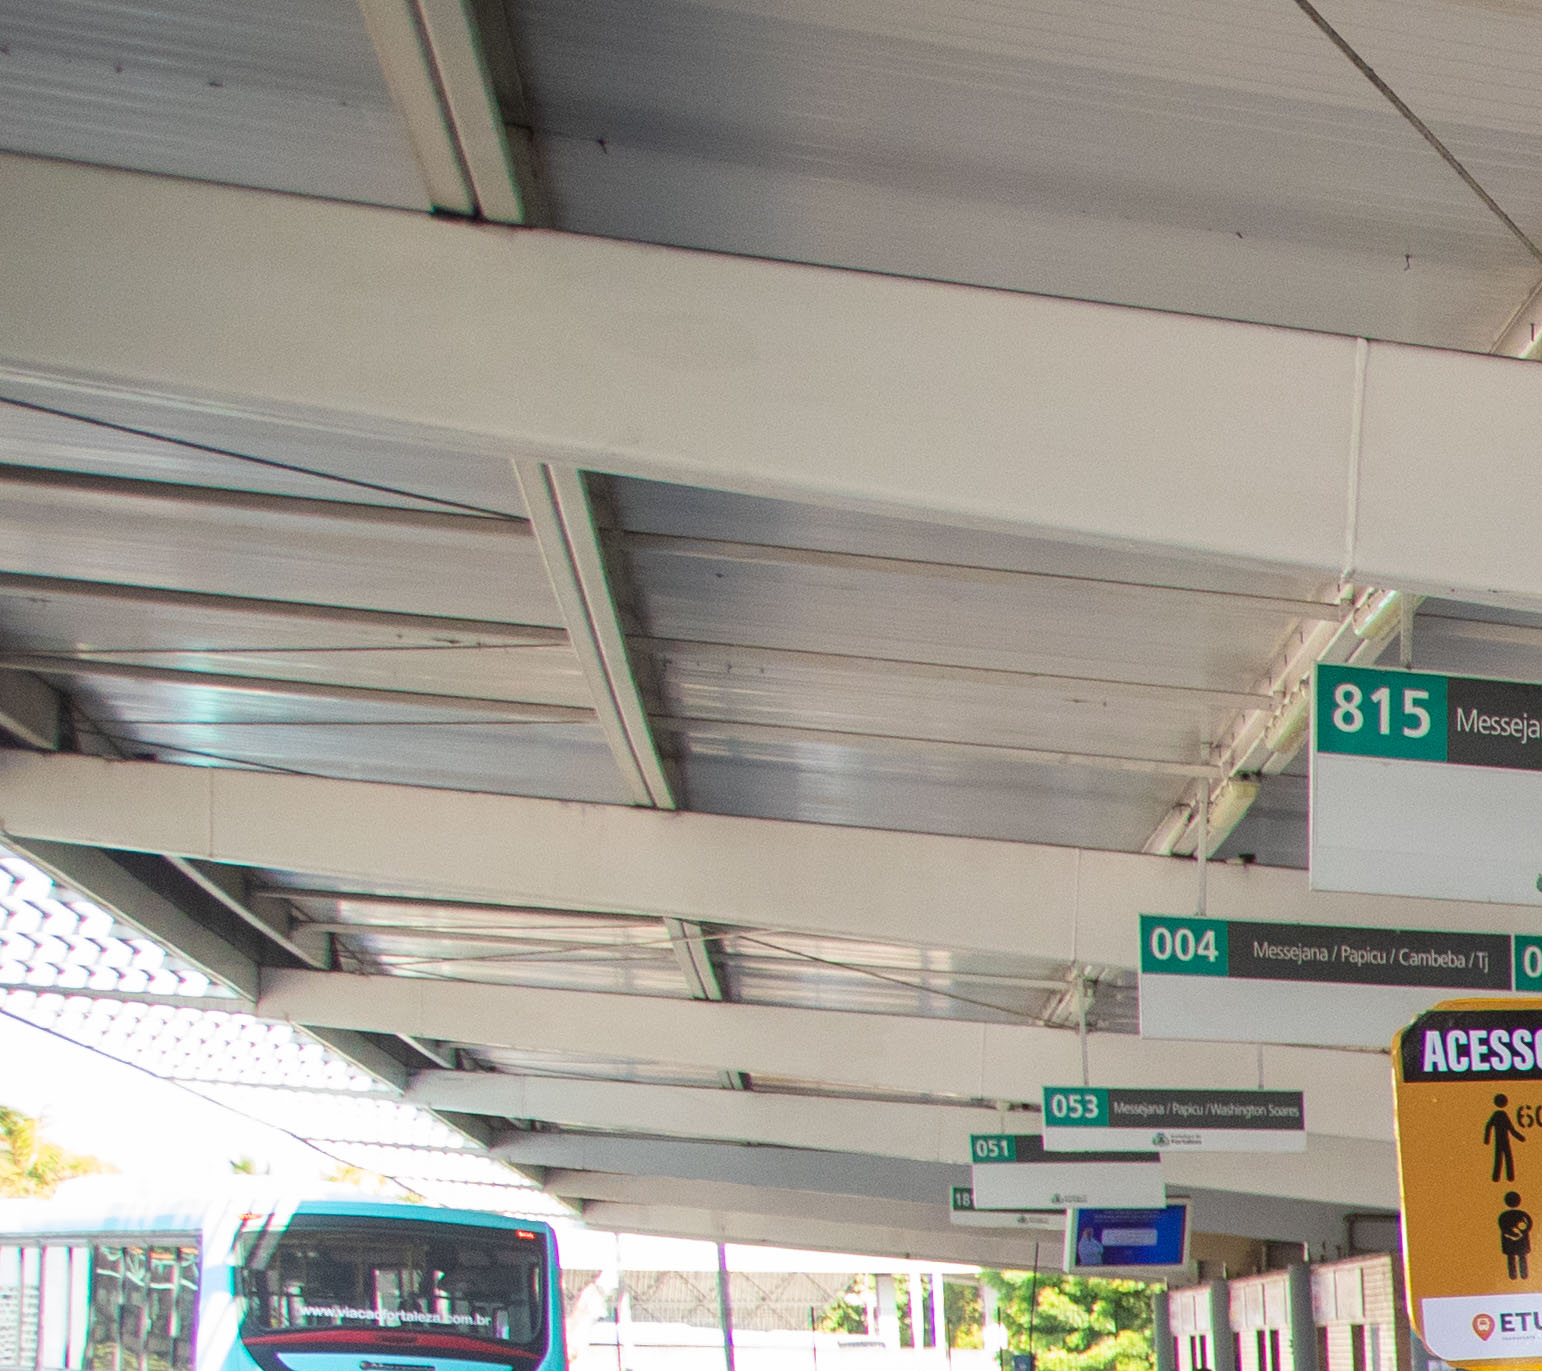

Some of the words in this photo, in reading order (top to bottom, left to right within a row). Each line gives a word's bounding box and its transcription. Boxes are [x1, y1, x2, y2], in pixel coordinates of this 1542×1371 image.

[1332, 683, 1432, 739] 815
[1151, 927, 1218, 962] 004
[1253, 941, 1328, 965] Messejana
[1341, 949, 1387, 967] Papicu
[1399, 948, 1466, 969] Cambeba
[1477, 952, 1489, 973] Tj
[1051, 1094, 1099, 1119] 053
[1113, 1101, 1165, 1118] Messejana
[1173, 1102, 1204, 1118] Papicu
[1268, 1105, 1300, 1117] Soares
[976, 1140, 1009, 1157] 051
